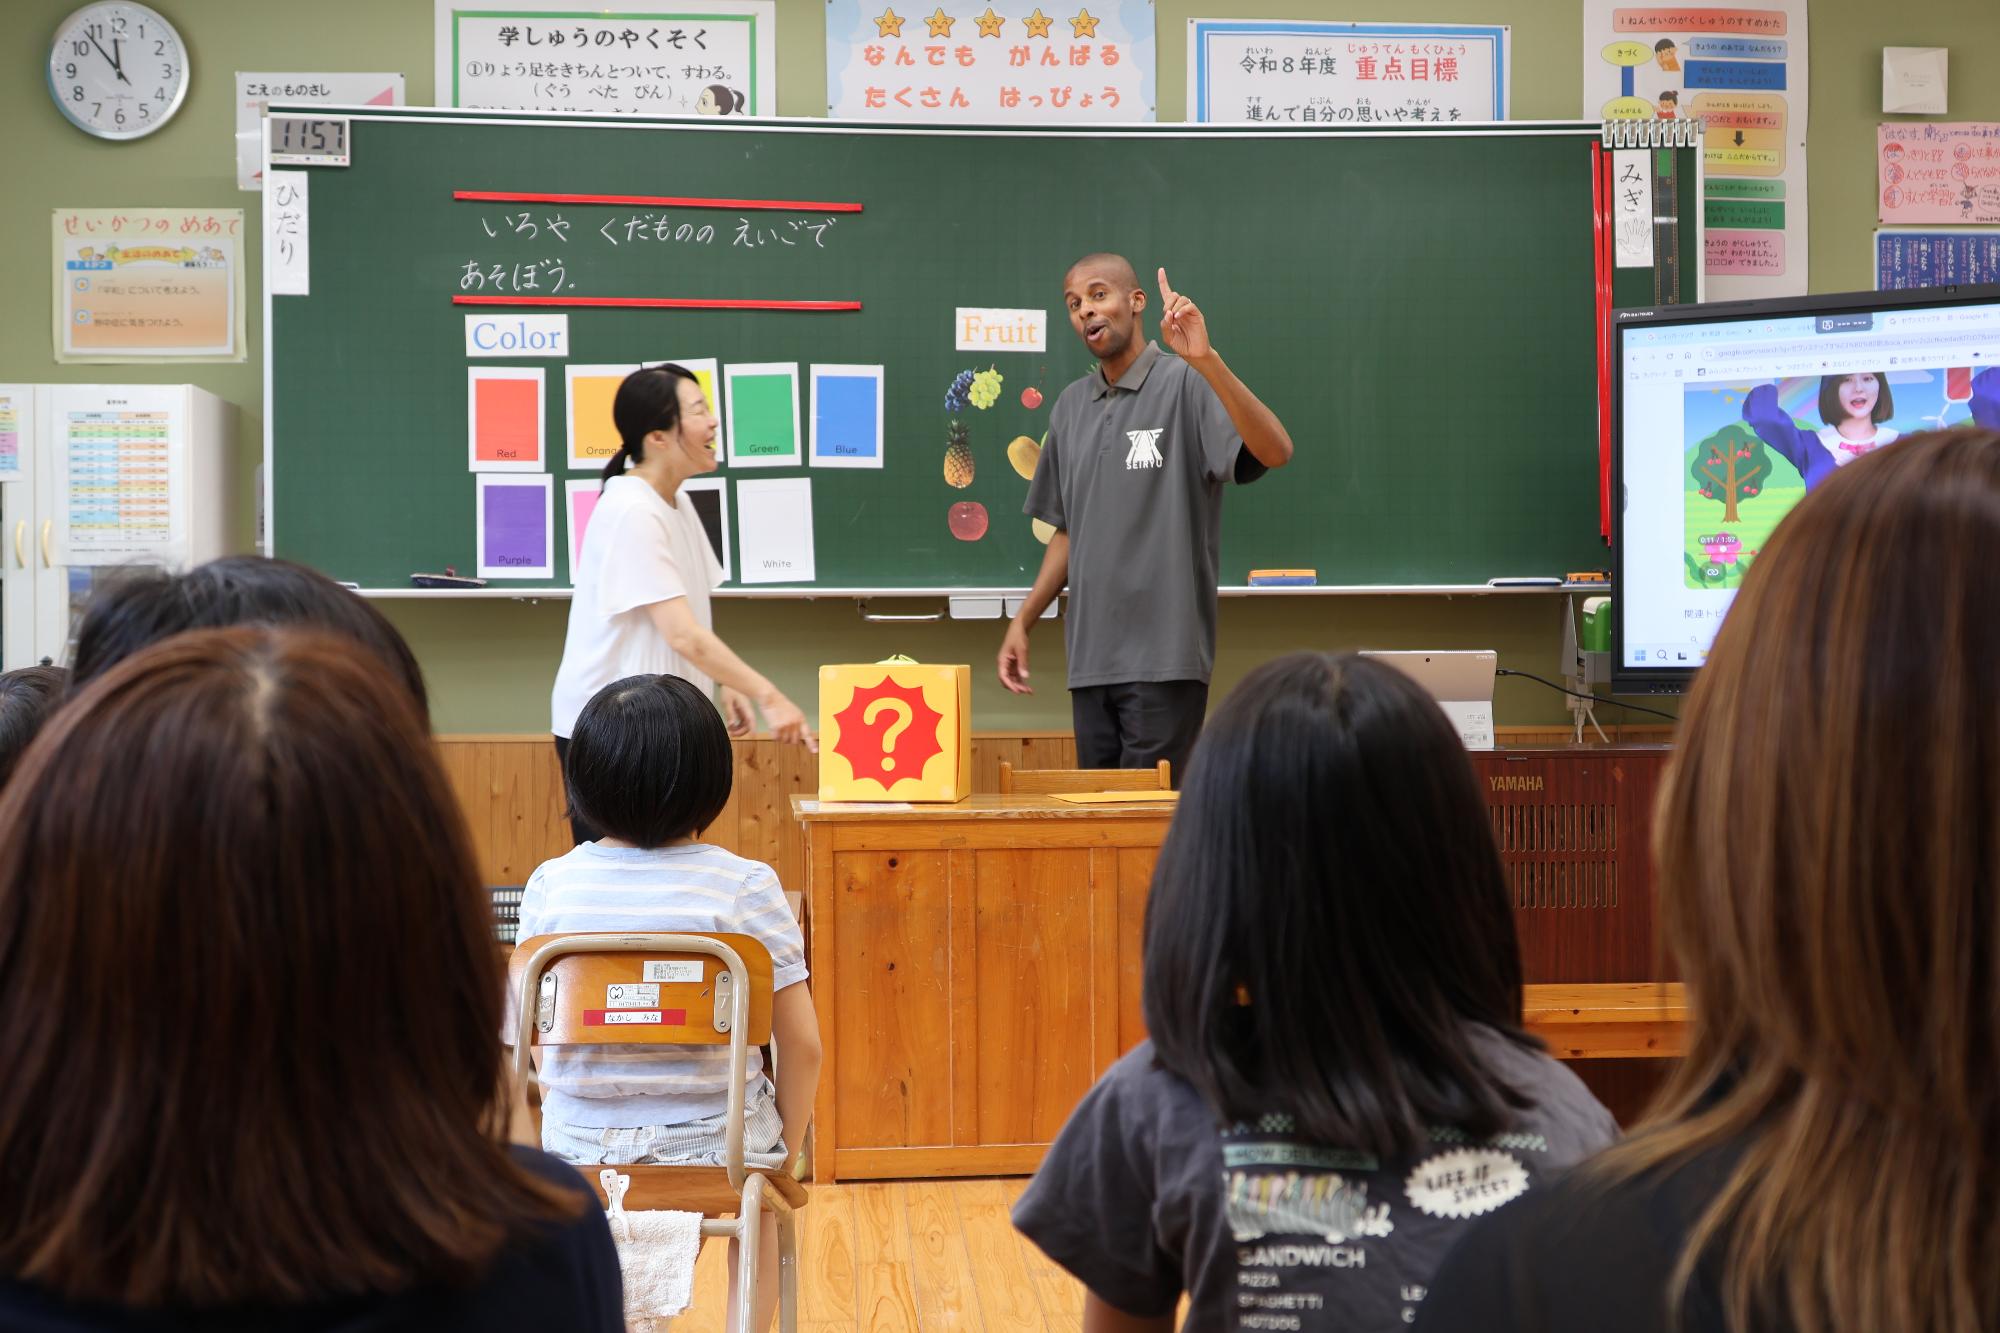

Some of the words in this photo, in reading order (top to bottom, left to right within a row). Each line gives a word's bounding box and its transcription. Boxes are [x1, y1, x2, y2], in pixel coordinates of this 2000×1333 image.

[89, 24, 103, 39] 11
[111, 18, 127, 33] 12
[138, 25, 145, 39] 1
[497, 26, 708, 50] 学しゅうのやくそく
[73, 41, 89, 56] 10
[154, 41, 165, 56] 2
[864, 45, 976, 67] なんでも
[1009, 45, 1120, 67] がんばる
[1246, 47, 1274, 55] れいわ
[1305, 47, 1332, 55] ねんど
[1347, 43, 1404, 55] じゅうてん
[1411, 44, 1467, 56] もくひょう
[1617, 49, 1638, 57] きづく
[66, 64, 77, 79] 9
[162, 64, 172, 79] 3
[1239, 55, 1337, 75] 令和8年度
[1355, 57, 1460, 82] 重点目標
[73, 86, 84, 101] 8
[154, 86, 165, 102] 4
[246, 83, 330, 97] こえのものさし
[864, 86, 970, 108] たくさん
[999, 86, 1121, 108] はっぴょう
[92, 103, 102, 118] 7
[114, 109, 126, 124] 6
[139, 103, 149, 118] 5
[1246, 104, 1462, 122] 進んで自分の思いや考えを
[1620, 164, 1644, 212] みぎ
[276, 184, 301, 264] ひだり
[482, 212, 571, 242] いろや
[599, 213, 714, 246] くだものの
[732, 216, 837, 247] えいごで
[472, 321, 561, 350] Color
[962, 314, 1038, 344] Fruit
[497, 448, 517, 459] Red
[749, 444, 779, 454] Green
[835, 444, 858, 454] Blue
[1126, 459, 1163, 470] SEIRYU
[498, 555, 532, 567] Purple
[762, 558, 791, 569] White
[1489, 776, 1544, 791] YAMAHA
[1237, 1245, 1366, 1268] SANDWICH
[1238, 1270, 1280, 1287] PIZZA
[1239, 1312, 1301, 1331] HOTDOG
